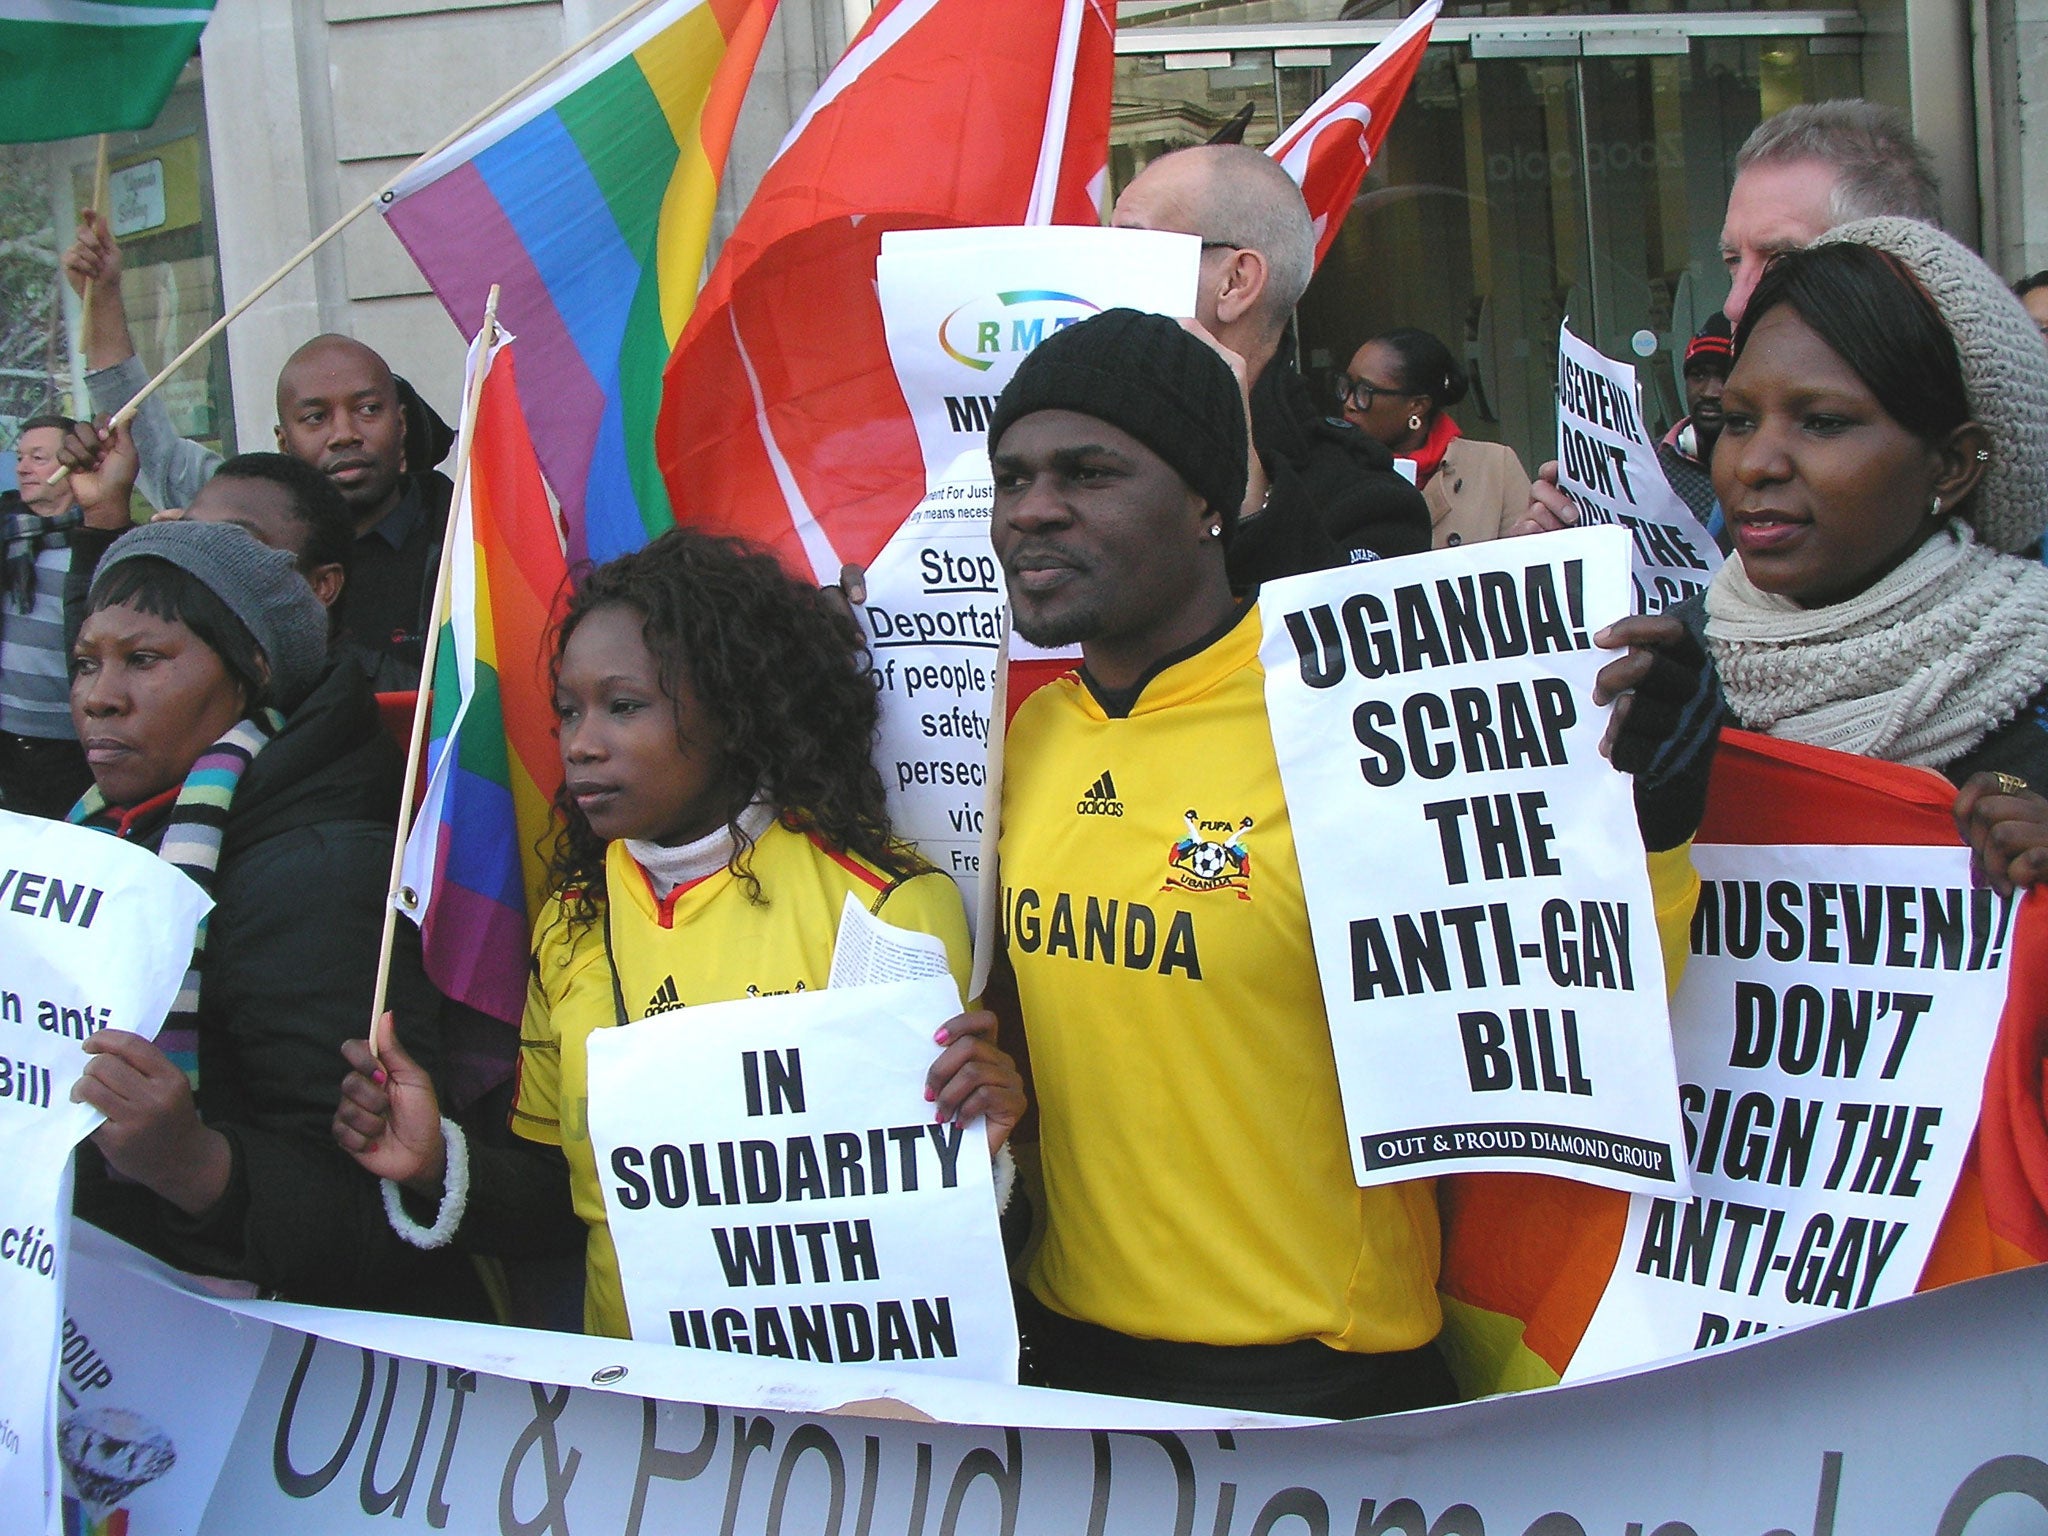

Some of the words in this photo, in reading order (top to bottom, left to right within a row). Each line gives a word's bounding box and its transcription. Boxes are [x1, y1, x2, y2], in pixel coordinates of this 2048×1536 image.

[946, 485, 964, 499] For
[1563, 421, 1637, 505] DON'T
[921, 549, 995, 590] Stop
[1617, 513, 1709, 571] THE
[1283, 559, 1591, 689] UGANDA!
[904, 659, 986, 698] people
[921, 706, 990, 749] safety
[1352, 677, 1578, 787] SCRAP
[1076, 800, 1124, 817] adidas
[1199, 821, 1233, 833] FUFA
[1423, 791, 1562, 885] THE
[1349, 898, 1635, 1002] ANTI-GAY
[1457, 1008, 1593, 1097] BILL
[1729, 981, 1934, 1080] DON'T
[741, 1048, 807, 1117] IN
[610, 1121, 965, 1211] SOLIDARITY
[1377, 1136, 1426, 1160] OUT
[1433, 1134, 1451, 1152] &
[1453, 1131, 1527, 1150] PROUD
[1532, 1132, 1610, 1160] DIAMOND
[1611, 1145, 1663, 1171] GROUP
[1824, 1103, 1944, 1198] THE
[711, 1219, 880, 1288] WITH
[1635, 1197, 1910, 1312] ANTI-GAY
[668, 1296, 959, 1364] UGANDAN
[273, 1333, 477, 1529] Out
[499, 1383, 582, 1536] &
[626, 1397, 1022, 1536] Proud
